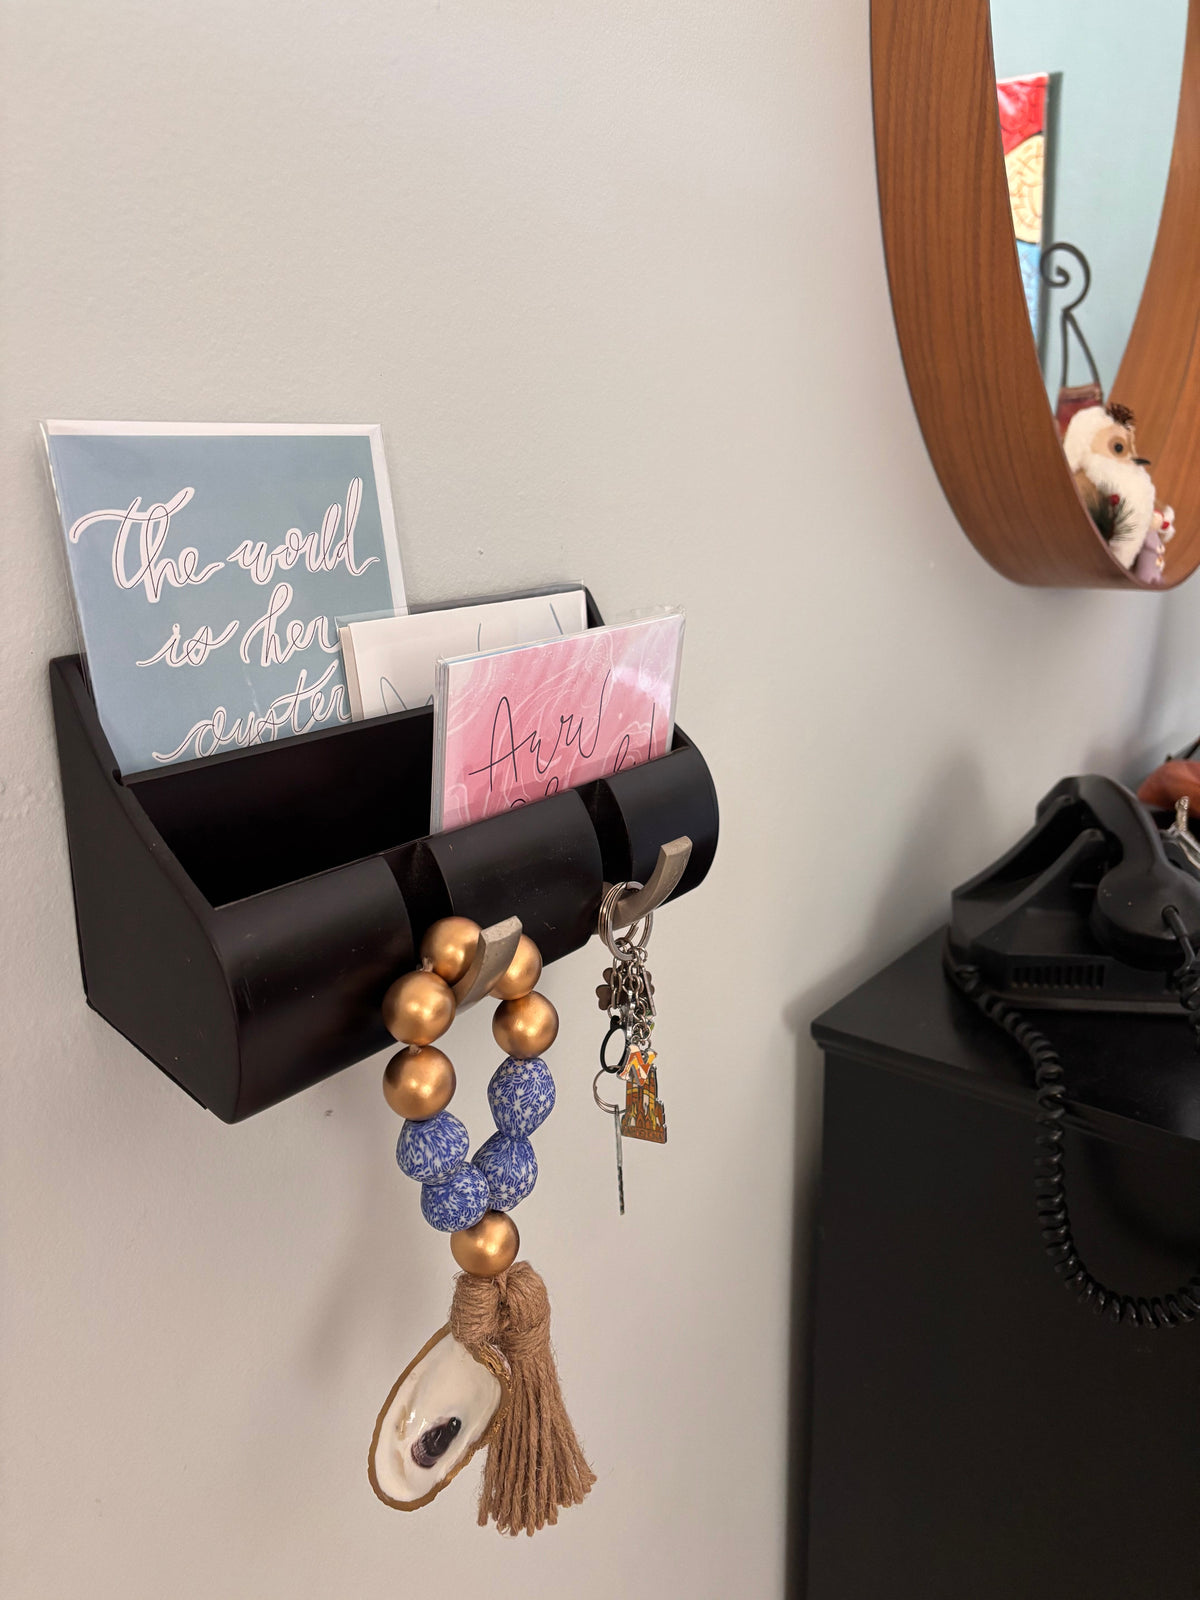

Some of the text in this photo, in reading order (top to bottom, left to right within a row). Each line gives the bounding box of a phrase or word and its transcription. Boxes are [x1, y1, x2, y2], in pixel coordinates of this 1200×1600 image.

[227, 476, 380, 585] world
[136, 583, 341, 667] is her
